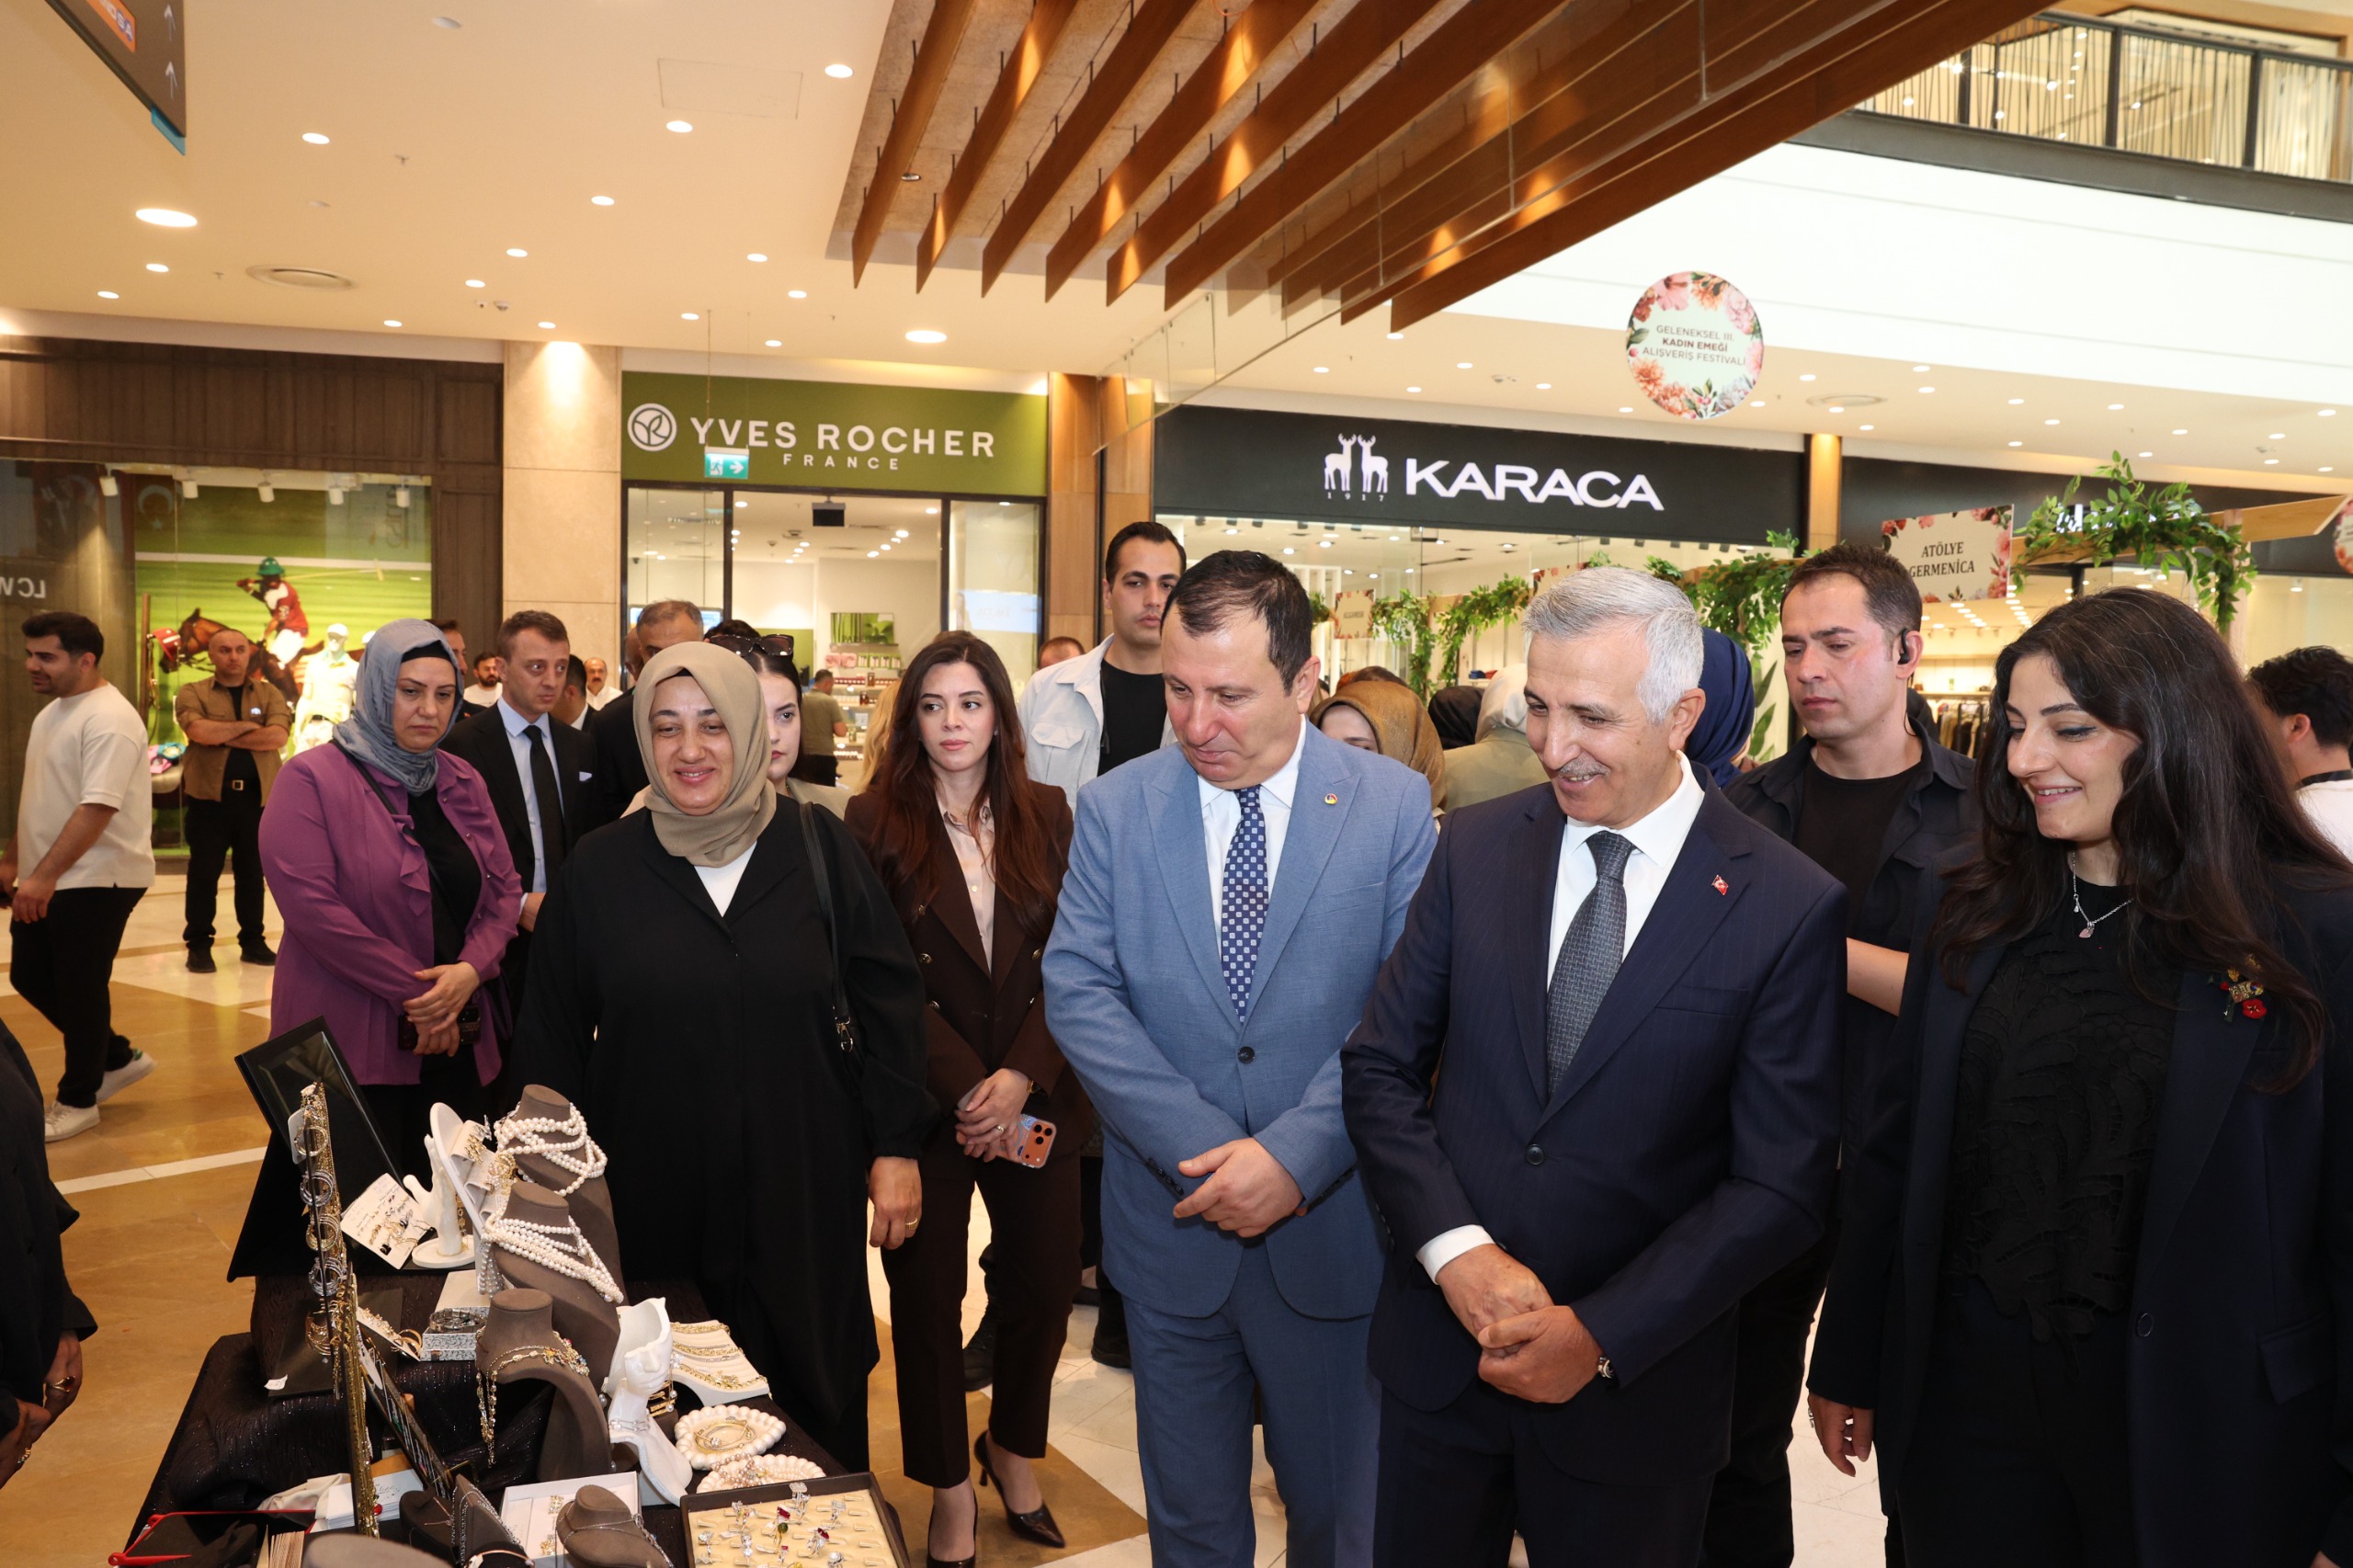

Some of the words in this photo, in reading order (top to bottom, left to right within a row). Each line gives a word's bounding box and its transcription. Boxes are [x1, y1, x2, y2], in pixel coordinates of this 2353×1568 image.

[1656, 324, 1721, 340] GELENEKSEL
[1662, 337, 1695, 348] KADIN
[1697, 340, 1728, 352] EMEĞİ
[1643, 347, 1694, 361] ALIŞVERİŞ
[690, 416, 797, 449] YVES
[817, 424, 995, 458] ROCHER
[783, 453, 899, 471] FRANCE
[1405, 458, 1665, 511] KARACA
[1921, 541, 1964, 558] ATÖLYE
[1909, 559, 1975, 578] GERMENİCA
